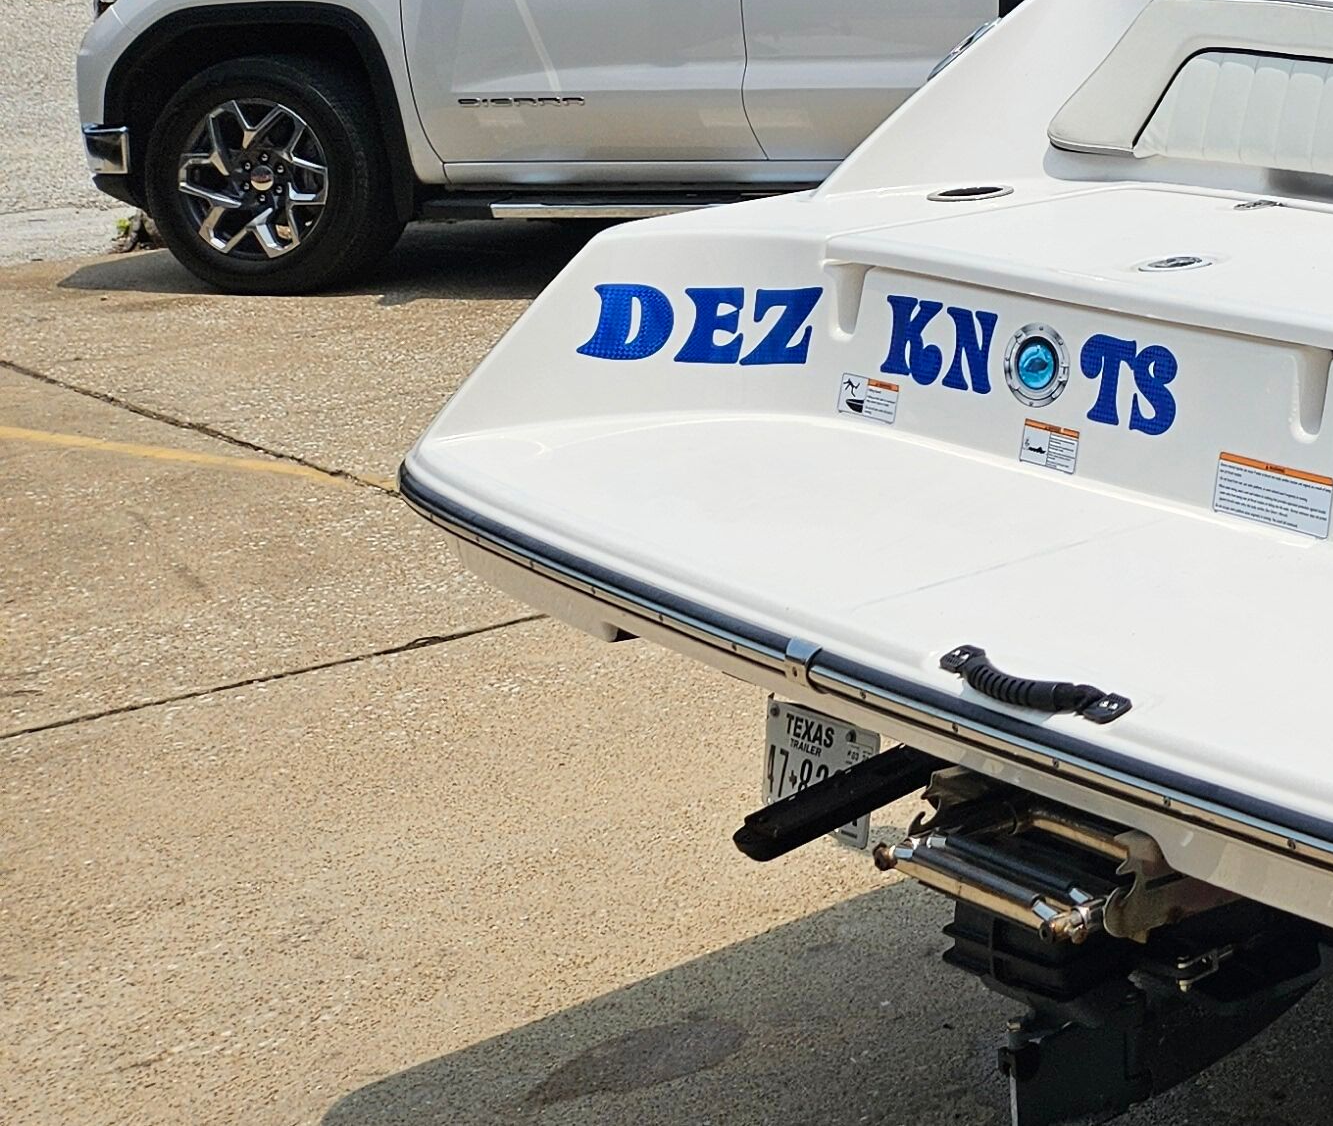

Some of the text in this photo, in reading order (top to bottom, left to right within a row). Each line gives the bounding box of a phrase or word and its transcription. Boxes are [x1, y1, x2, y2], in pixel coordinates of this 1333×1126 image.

[458, 96, 585, 108] SIERRA
[576, 283, 823, 365] DEZ
[786, 712, 835, 749] TEXAS
[791, 737, 822, 758] TRAILER
